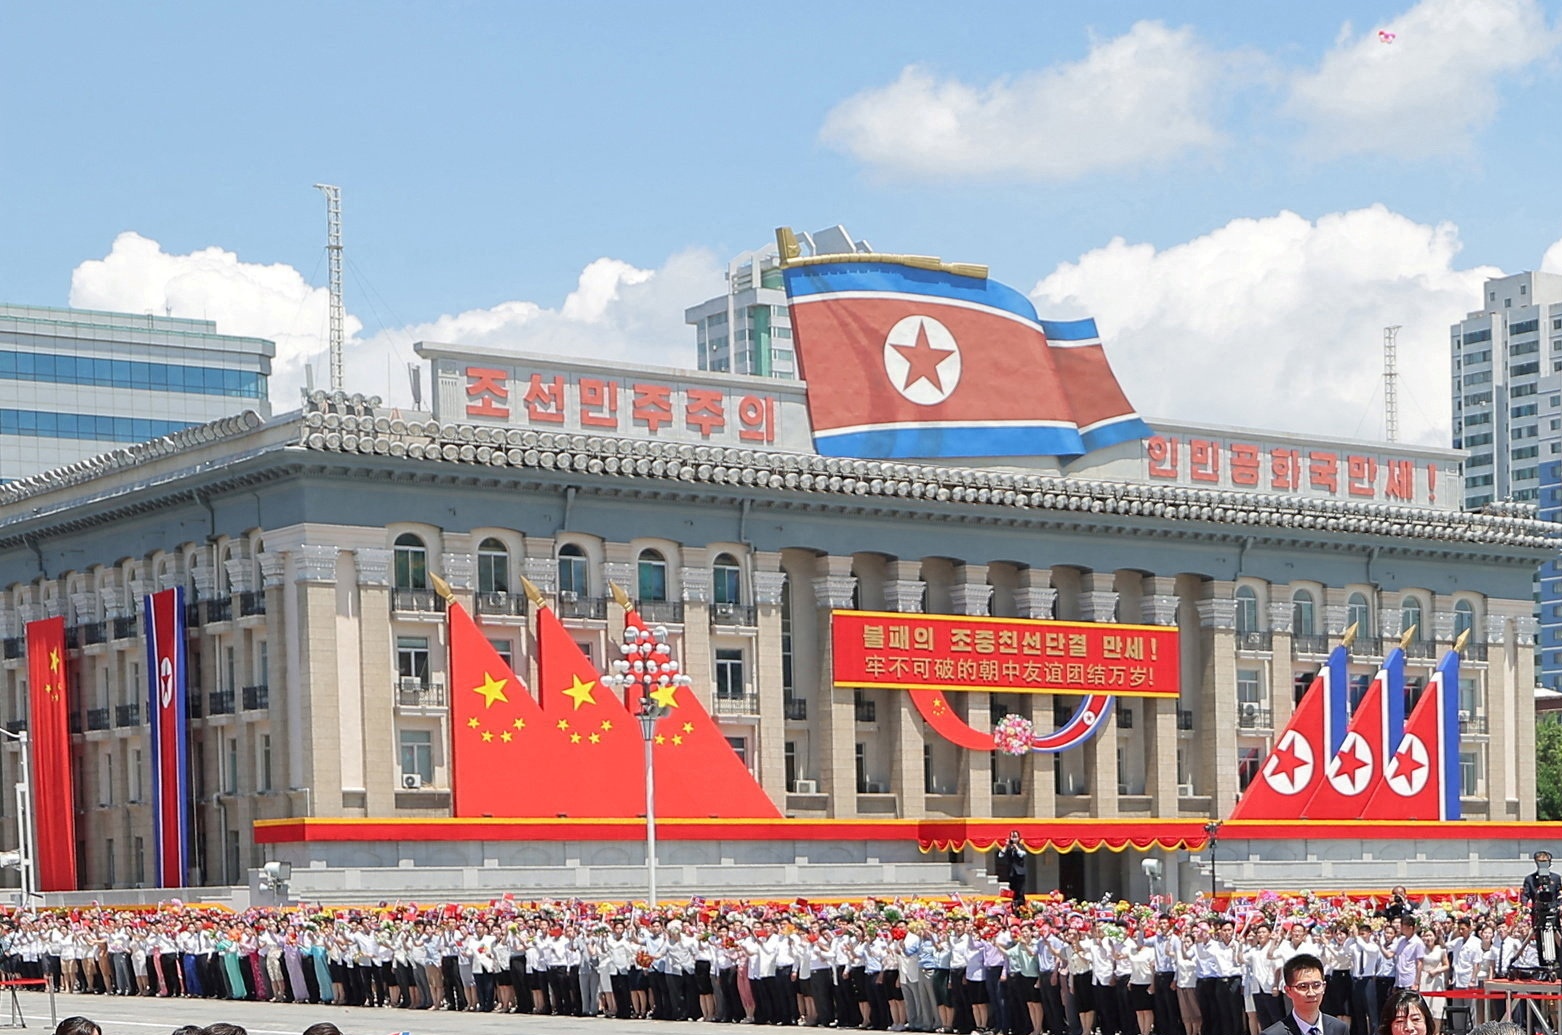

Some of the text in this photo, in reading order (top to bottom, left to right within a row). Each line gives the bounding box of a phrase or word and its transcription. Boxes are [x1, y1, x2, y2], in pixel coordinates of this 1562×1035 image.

[465, 366, 775, 442] 조선민주주의
[863, 624, 1158, 661] 불패의 조중친선단결 만세!
[865, 654, 1155, 687] 牢不可破的朝中友谊团结万岁!
